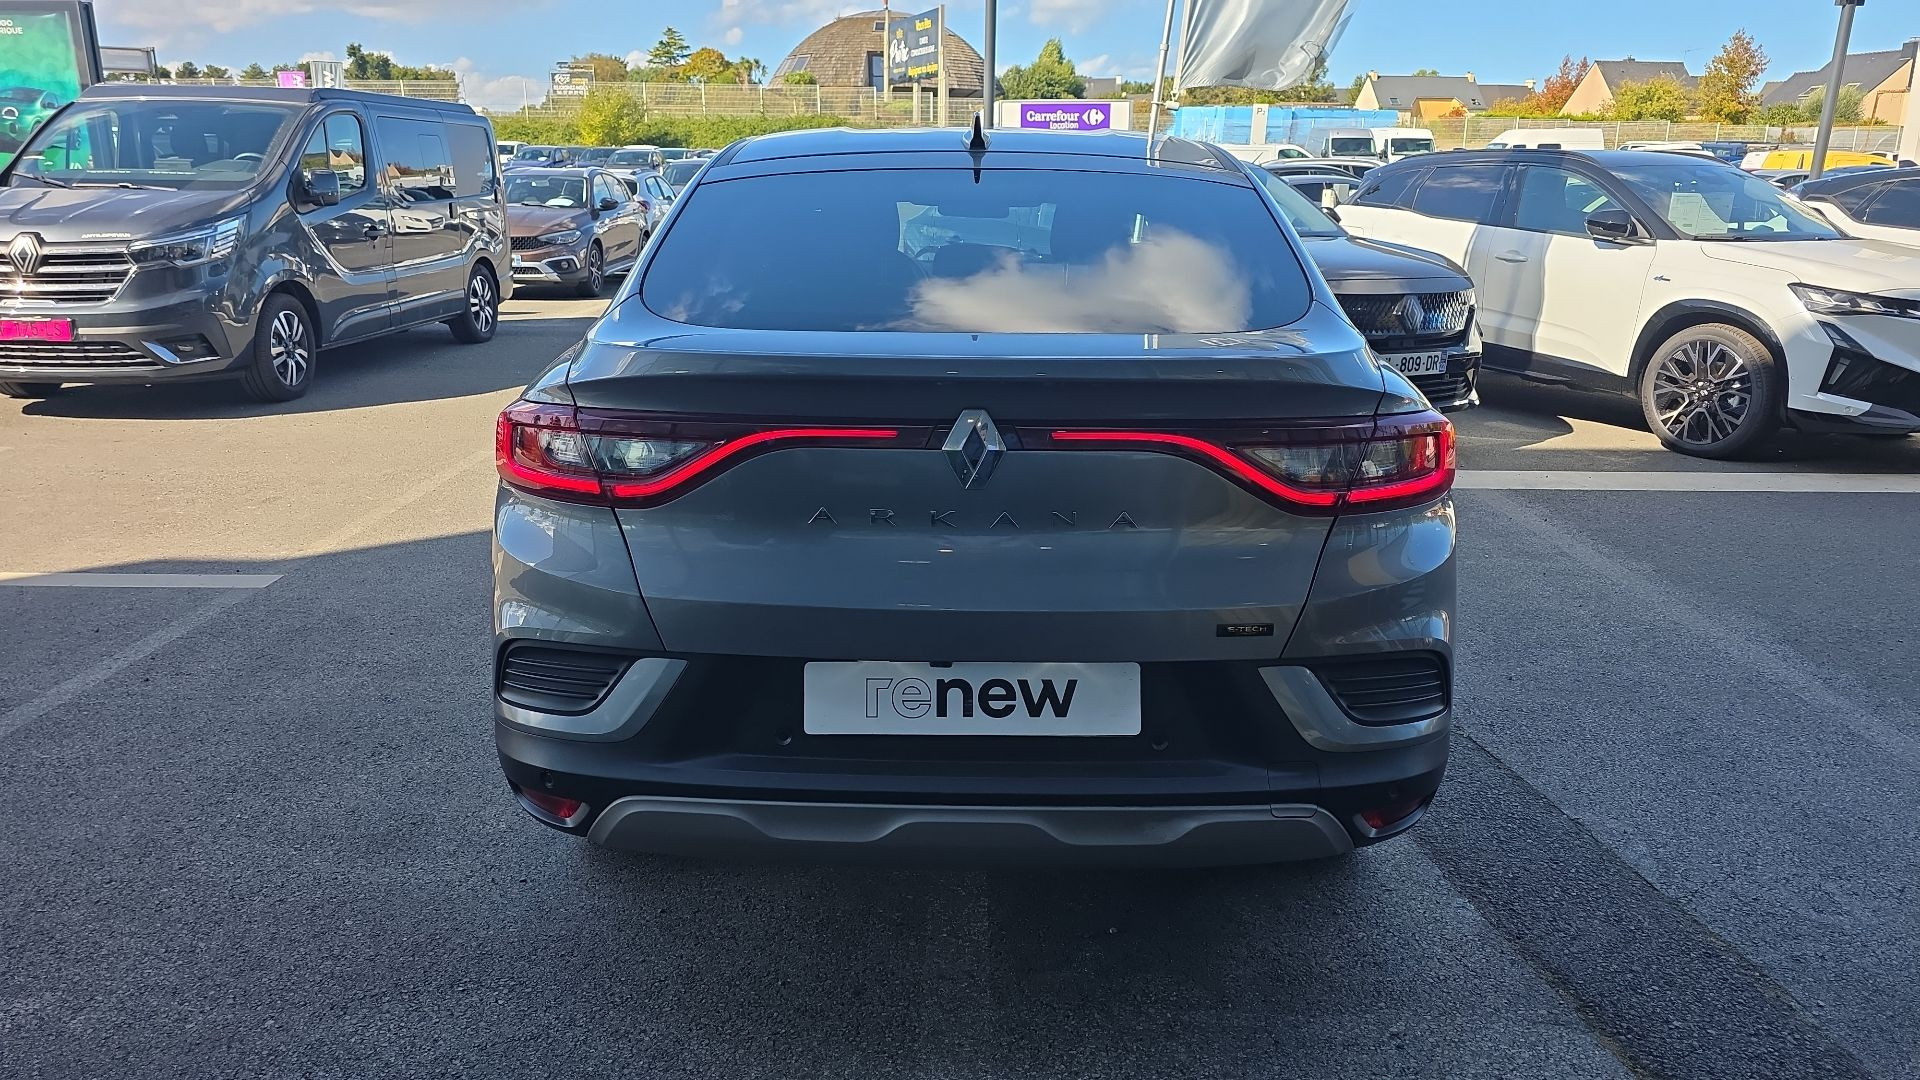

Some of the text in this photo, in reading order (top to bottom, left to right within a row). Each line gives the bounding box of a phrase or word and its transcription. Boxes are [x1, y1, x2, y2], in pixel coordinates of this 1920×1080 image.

[1026, 110, 1080, 122] Carrefour
[1049, 121, 1079, 130] Location
[808, 506, 1140, 529] ARKANA
[865, 677, 1079, 719] renew
